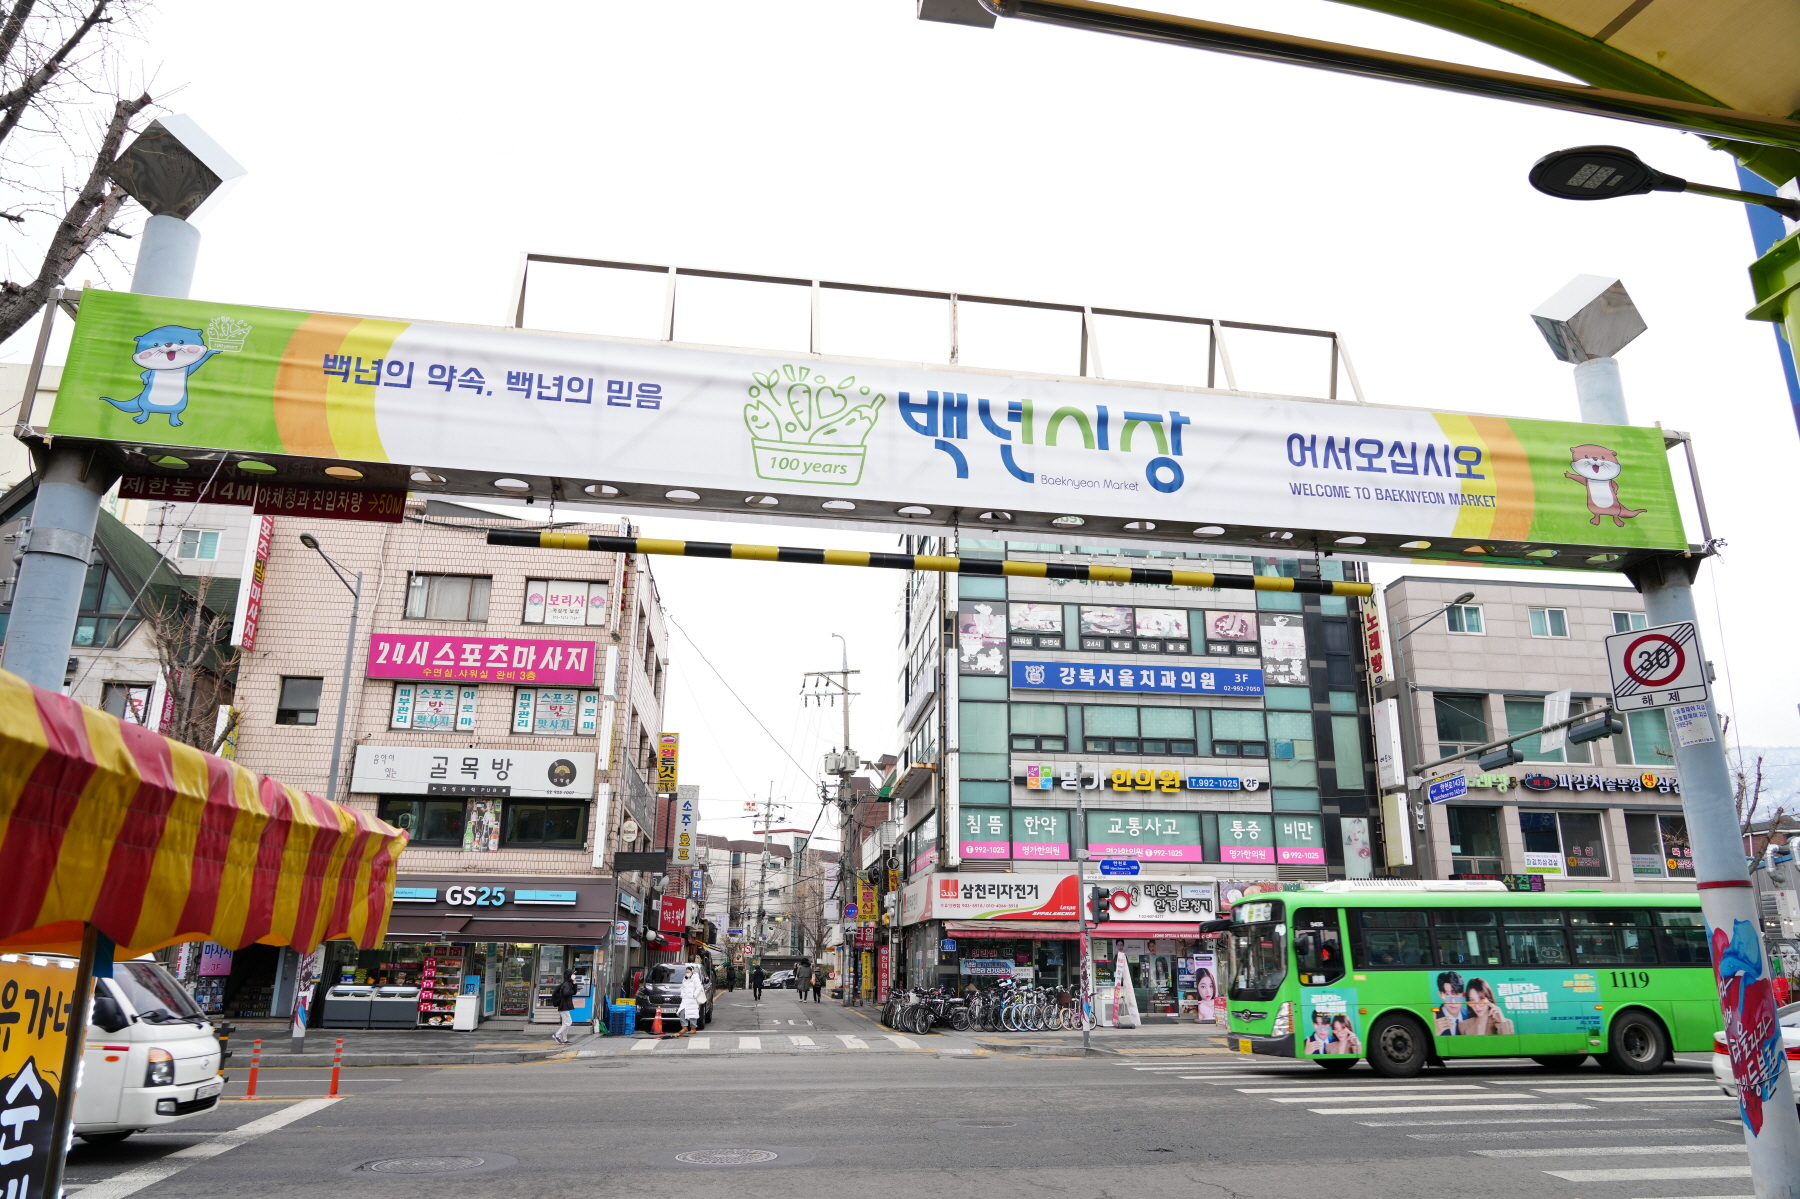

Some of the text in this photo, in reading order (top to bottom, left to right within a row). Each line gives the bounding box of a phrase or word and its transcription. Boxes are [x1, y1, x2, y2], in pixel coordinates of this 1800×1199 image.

[322, 353, 413, 390] 백년의
[505, 369, 596, 403] 백년의
[605, 380, 664, 410] 믿음
[769, 455, 849, 476] 100 years
[1286, 432, 1486, 481] 어서오십시오
[1041, 474, 1139, 492] Baeknyeon Market
[1289, 482, 1497, 509] WELCOME TO BAEKNYEON MARKET
[548, 594, 586, 607] 보리사
[242, 637, 253, 649] 3F
[1041, 638, 1060, 646] 수면실
[1366, 612, 1383, 674] 노래방
[375, 641, 589, 672] 24시스포츠마사지
[1638, 648, 1670, 671] 30
[495, 669, 516, 680] 완비
[519, 671, 537, 681] 3층
[1059, 667, 1216, 690] 강북서울치과의원
[1234, 673, 1249, 683] 3F
[420, 688, 454, 700] 스포츠
[541, 692, 575, 704] 스포츠
[396, 688, 412, 724] 피부관리
[428, 700, 444, 713] 발
[460, 691, 476, 727] 아로마
[516, 693, 532, 728] 피부관리
[548, 704, 565, 717] 발
[582, 695, 598, 731] 아로마
[416, 715, 451, 727] 맛사지
[537, 719, 571, 730] 맛사지
[1190, 778, 1238, 788] T.992-1025
[1246, 779, 1258, 788] 2F
[1557, 773, 1604, 791] 파김치
[1605, 777, 1642, 792] 솥뚜껑
[966, 814, 1004, 834] 침 뜸
[1024, 816, 1057, 836] 한약
[1107, 817, 1180, 836] 교통사고
[1230, 820, 1262, 840] 통증
[1284, 821, 1314, 840] 비만
[974, 846, 1005, 854] 992-1025
[1022, 846, 1060, 856] 명가한의원
[1229, 850, 1266, 860] 명가한의원
[445, 886, 506, 906] GS25
[960, 884, 1039, 900] 삼천리자전거
[1144, 884, 1179, 898] 레온느
[1154, 898, 1213, 913] 안경 보청기
[1610, 971, 1650, 989] 1119
